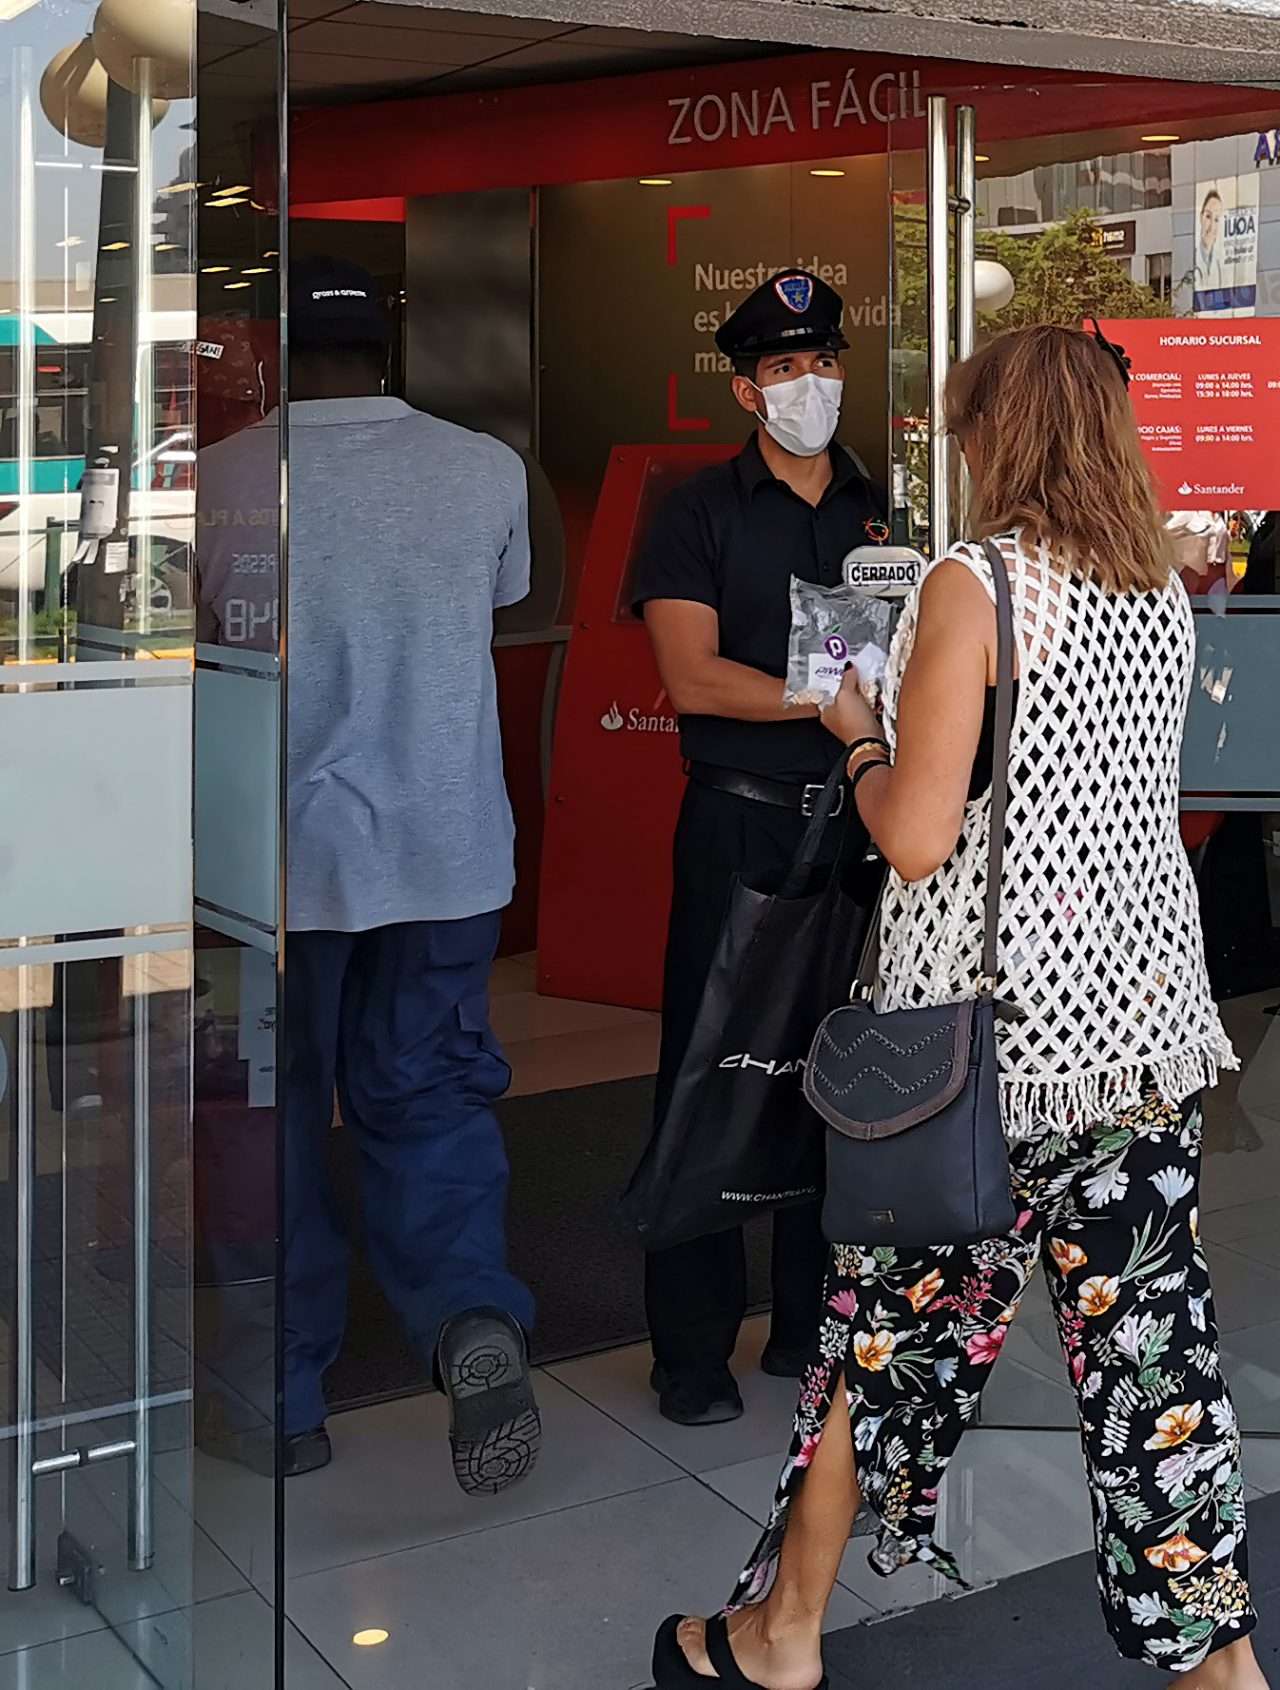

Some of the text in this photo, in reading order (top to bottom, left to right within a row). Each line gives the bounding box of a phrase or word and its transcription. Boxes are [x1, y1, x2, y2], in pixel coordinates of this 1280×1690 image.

[668, 68, 927, 145] ZONA FÁCIL
[694, 262, 786, 291] Nuestr
[694, 310, 720, 332] es
[849, 297, 901, 326] vida
[1159, 335, 1262, 346] HORARIO SUCURSAL
[1135, 373, 1182, 381] COMERCIAL:
[1198, 373, 1219, 381] LUNES
[1227, 372, 1251, 381] JUEVES
[1155, 425, 1182, 433] CAJAS:
[1196, 425, 1218, 433] LUNES
[1226, 425, 1253, 433] VIERNES
[1194, 483, 1245, 495] Santander
[851, 566, 916, 582] CERRADO
